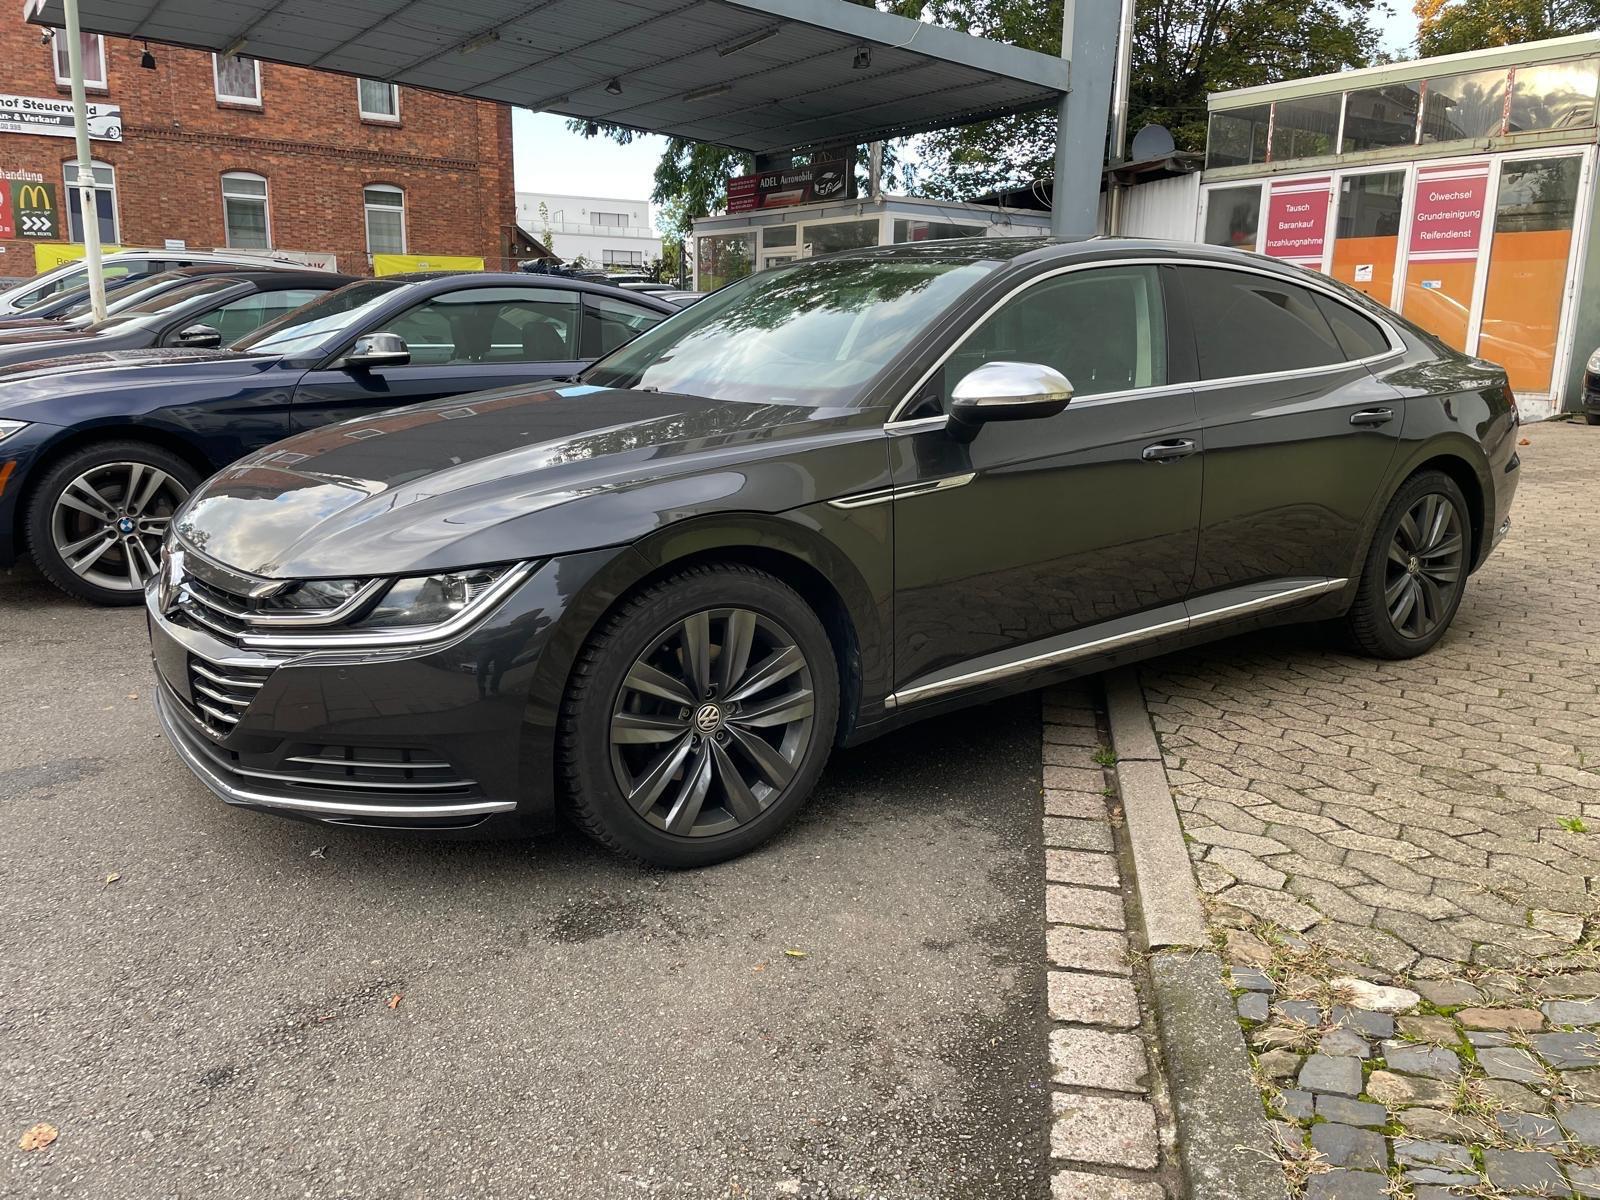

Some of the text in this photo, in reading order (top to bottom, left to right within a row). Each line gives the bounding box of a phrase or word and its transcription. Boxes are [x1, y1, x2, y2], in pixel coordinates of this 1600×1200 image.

[13, 113, 21, 121] &
[22, 113, 60, 124] Verkauf
[760, 176, 778, 188] ADEL
[1429, 189, 1472, 202] Ölwechsel
[1286, 203, 1310, 213] Tausch
[1417, 209, 1481, 221] Grundreinigung
[1278, 219, 1314, 230] Barankauf
[1420, 229, 1472, 240] Reifendienst
[1267, 237, 1323, 248] Inzahlungnahme
